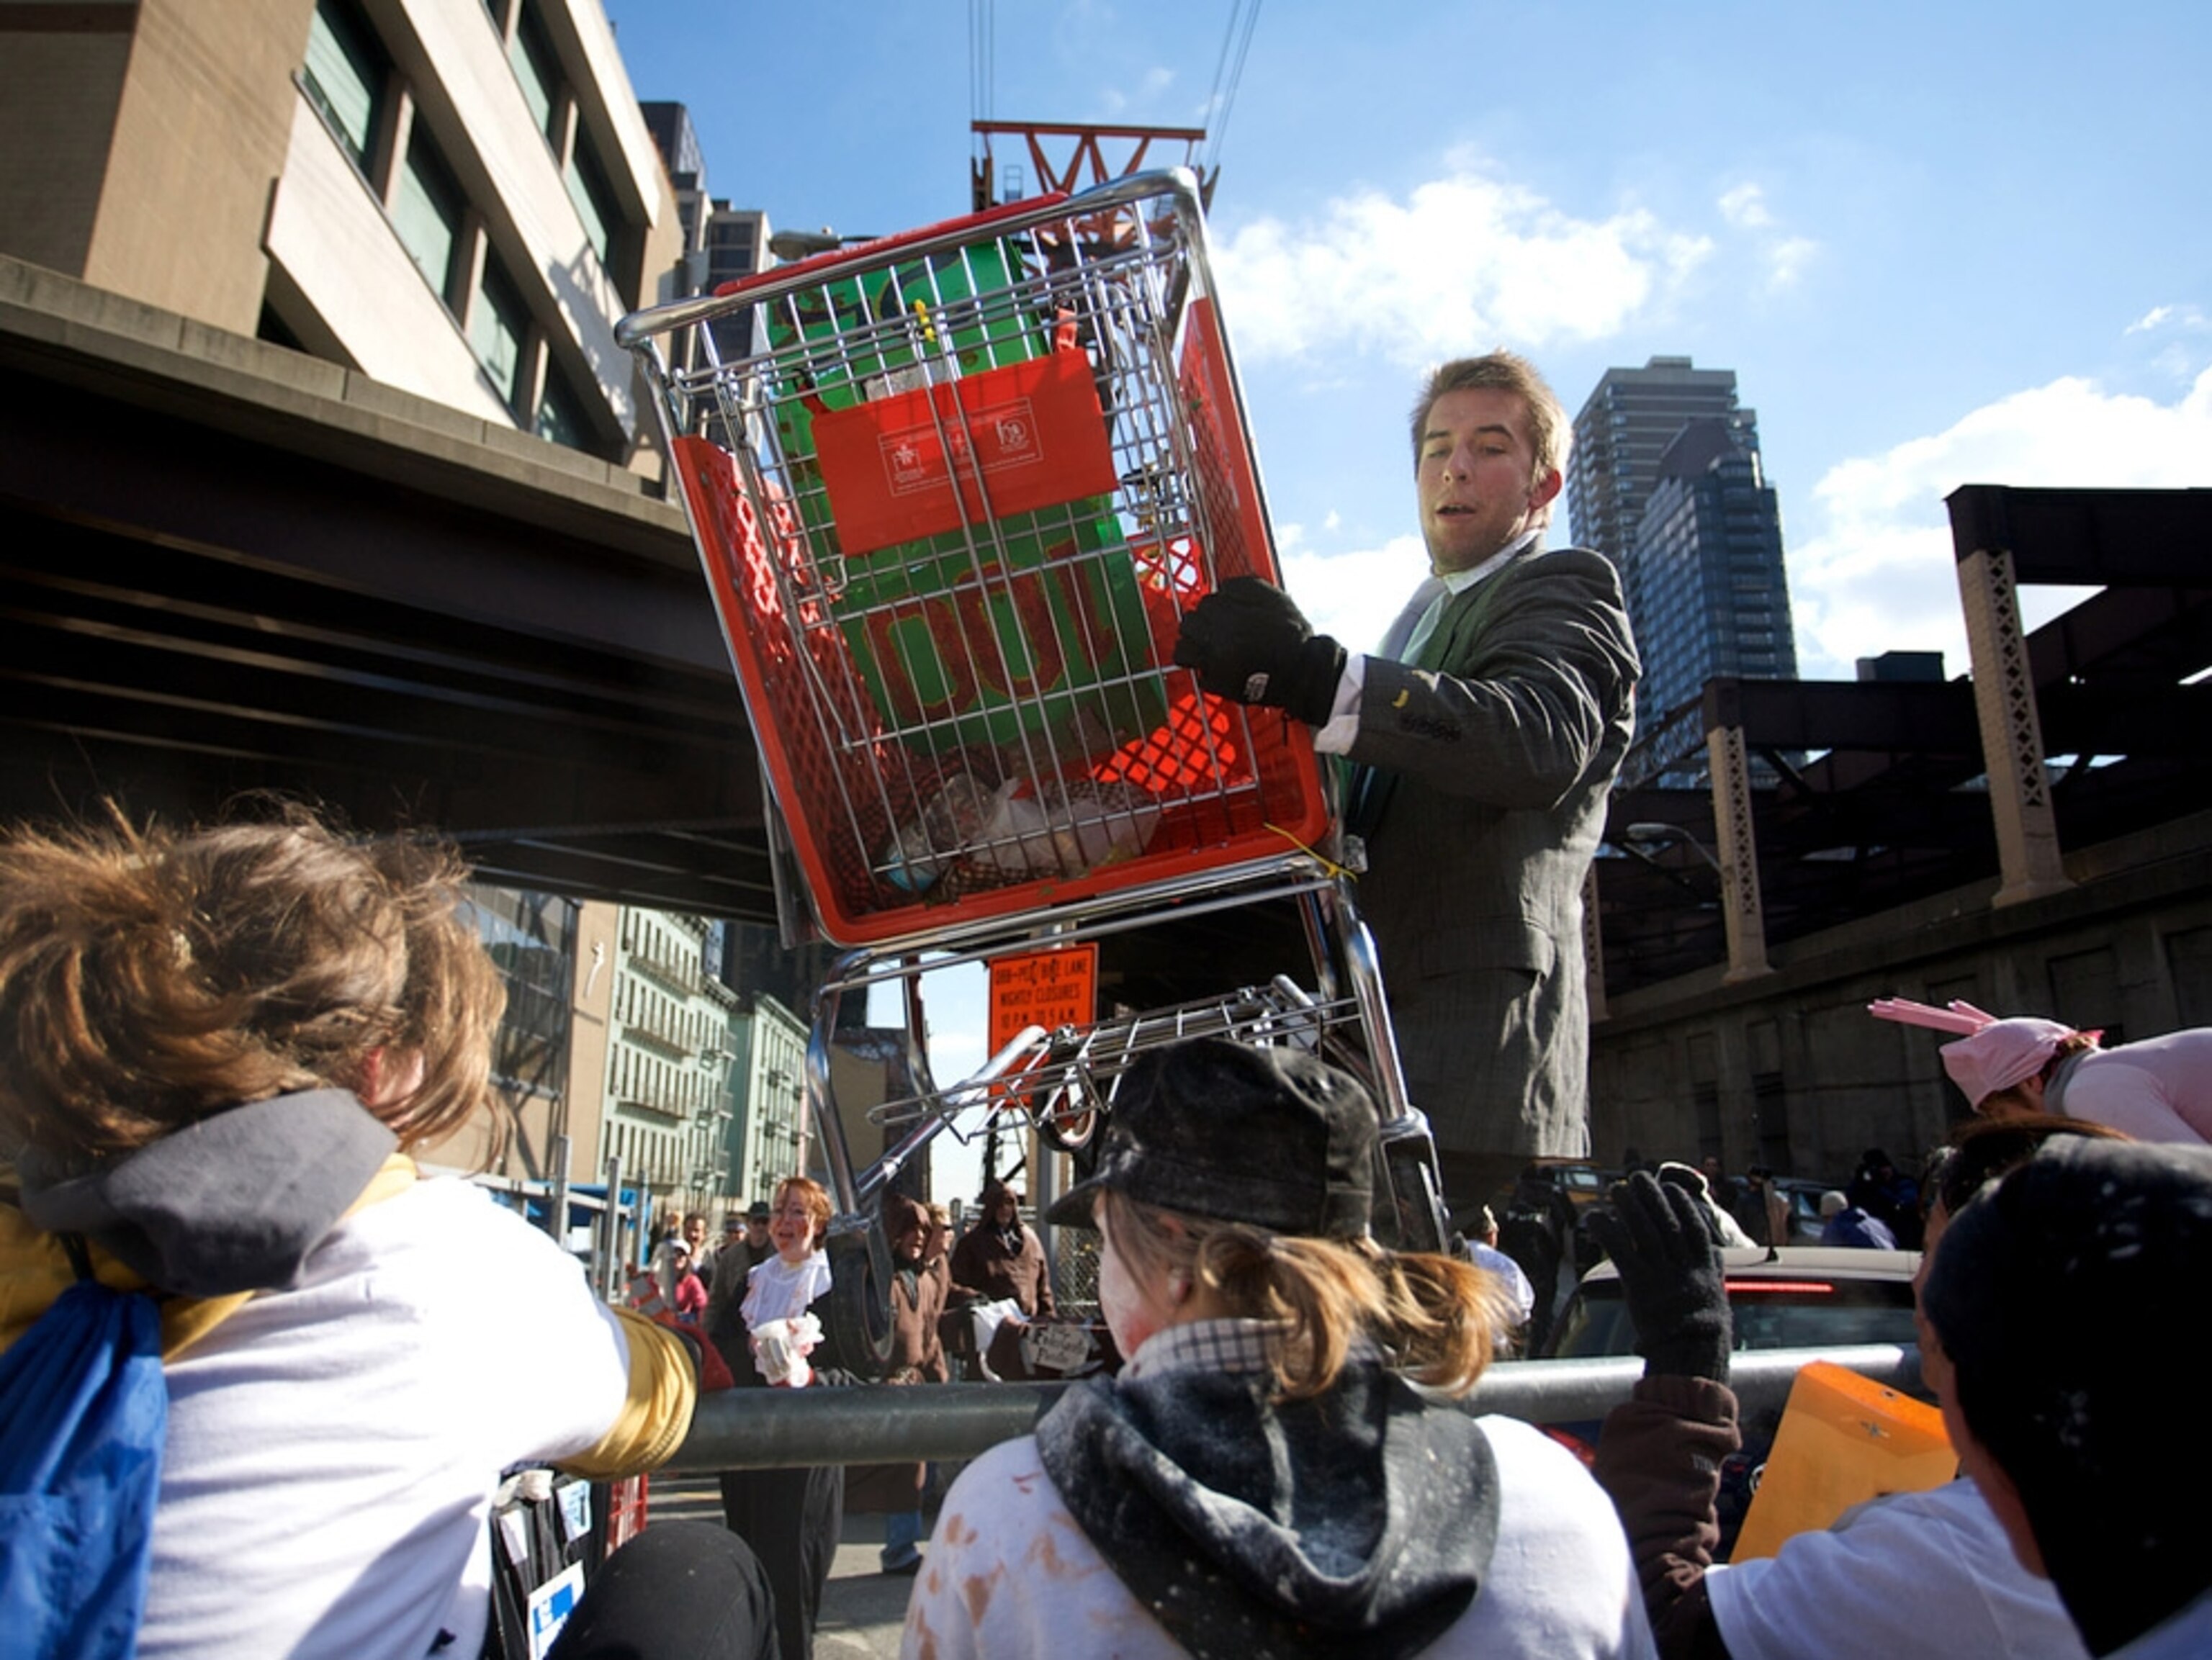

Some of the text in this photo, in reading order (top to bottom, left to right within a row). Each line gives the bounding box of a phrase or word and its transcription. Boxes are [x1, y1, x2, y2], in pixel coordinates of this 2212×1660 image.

[1065, 957, 1087, 976] LANE
[1001, 983, 1080, 1006] NIGHTLY CLOSURES
